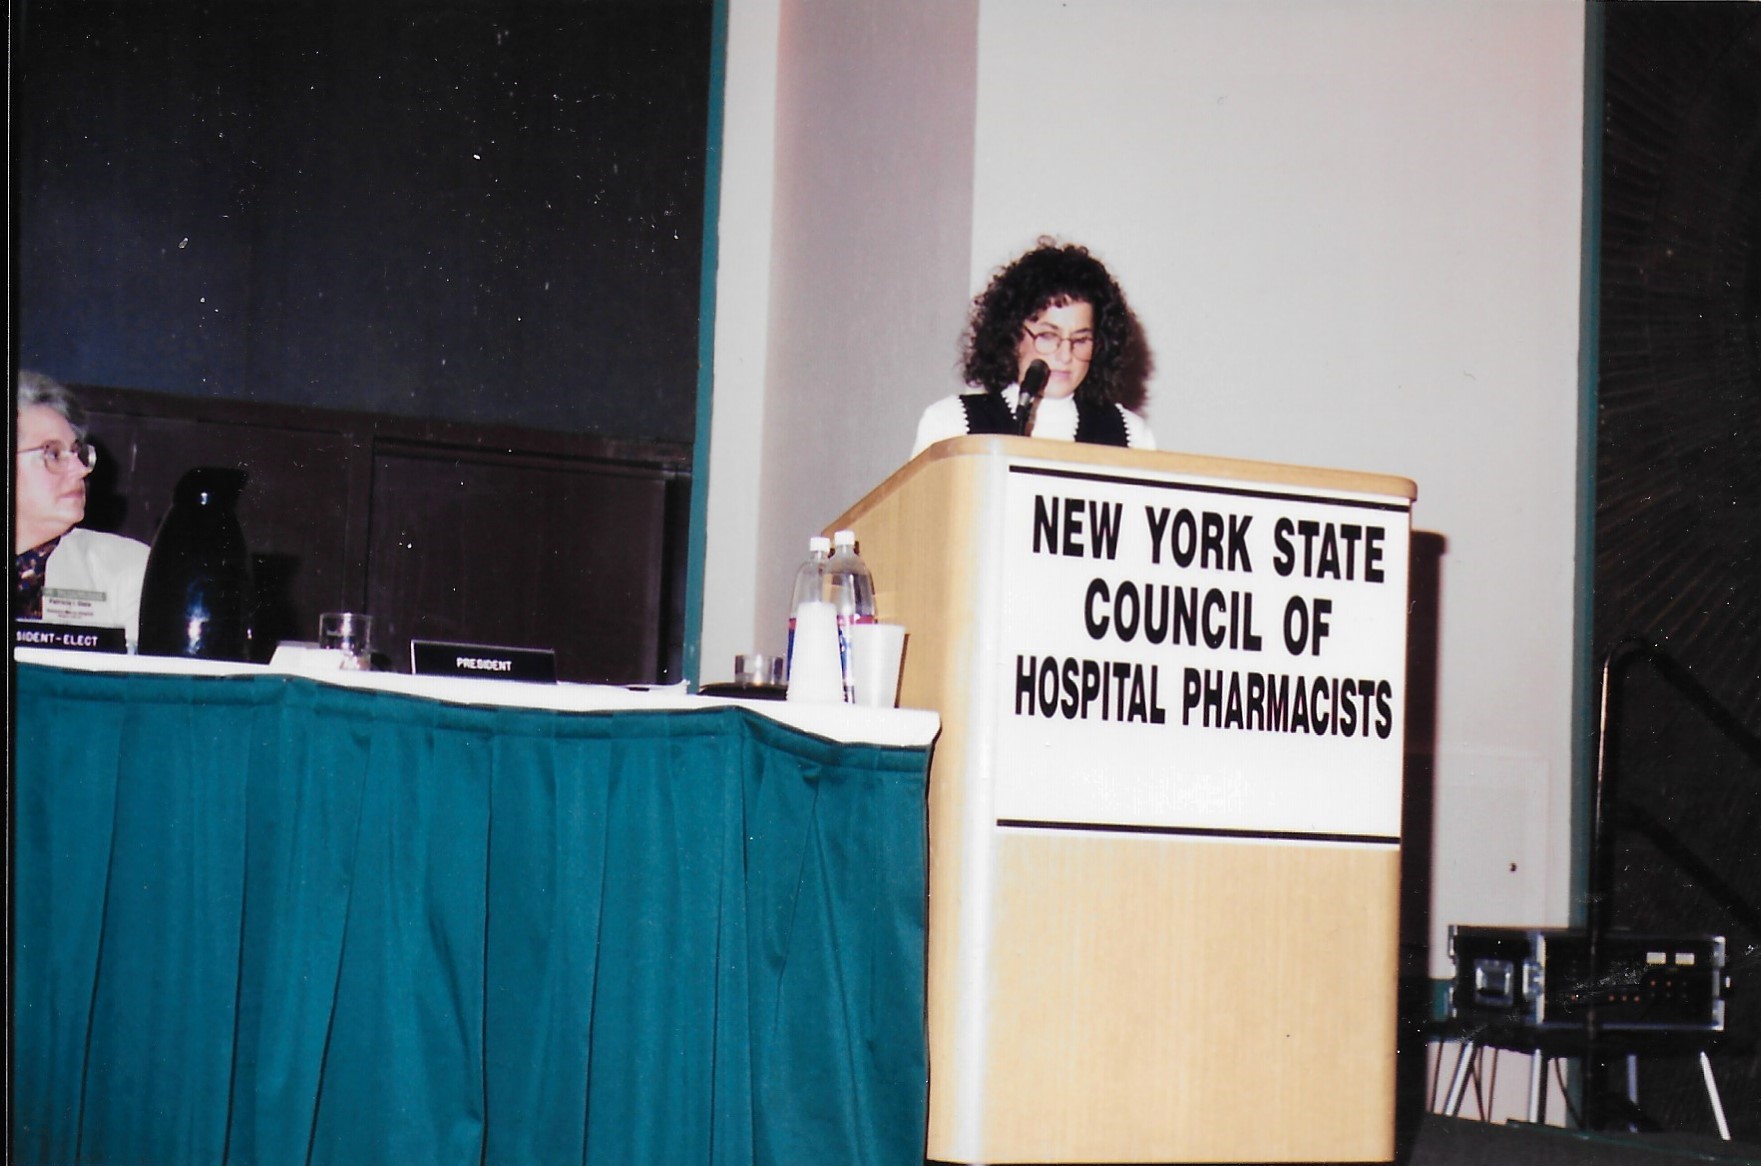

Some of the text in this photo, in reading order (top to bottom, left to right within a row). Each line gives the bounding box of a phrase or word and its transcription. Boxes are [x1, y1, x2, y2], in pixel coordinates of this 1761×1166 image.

[1033, 494, 1385, 584] NEW YORK STATE
[1084, 577, 1333, 656] COUNCIL OF
[456, 656, 512, 671] PRESIDENT
[1015, 654, 1393, 739] HOSPITAL PHARMACISTS
